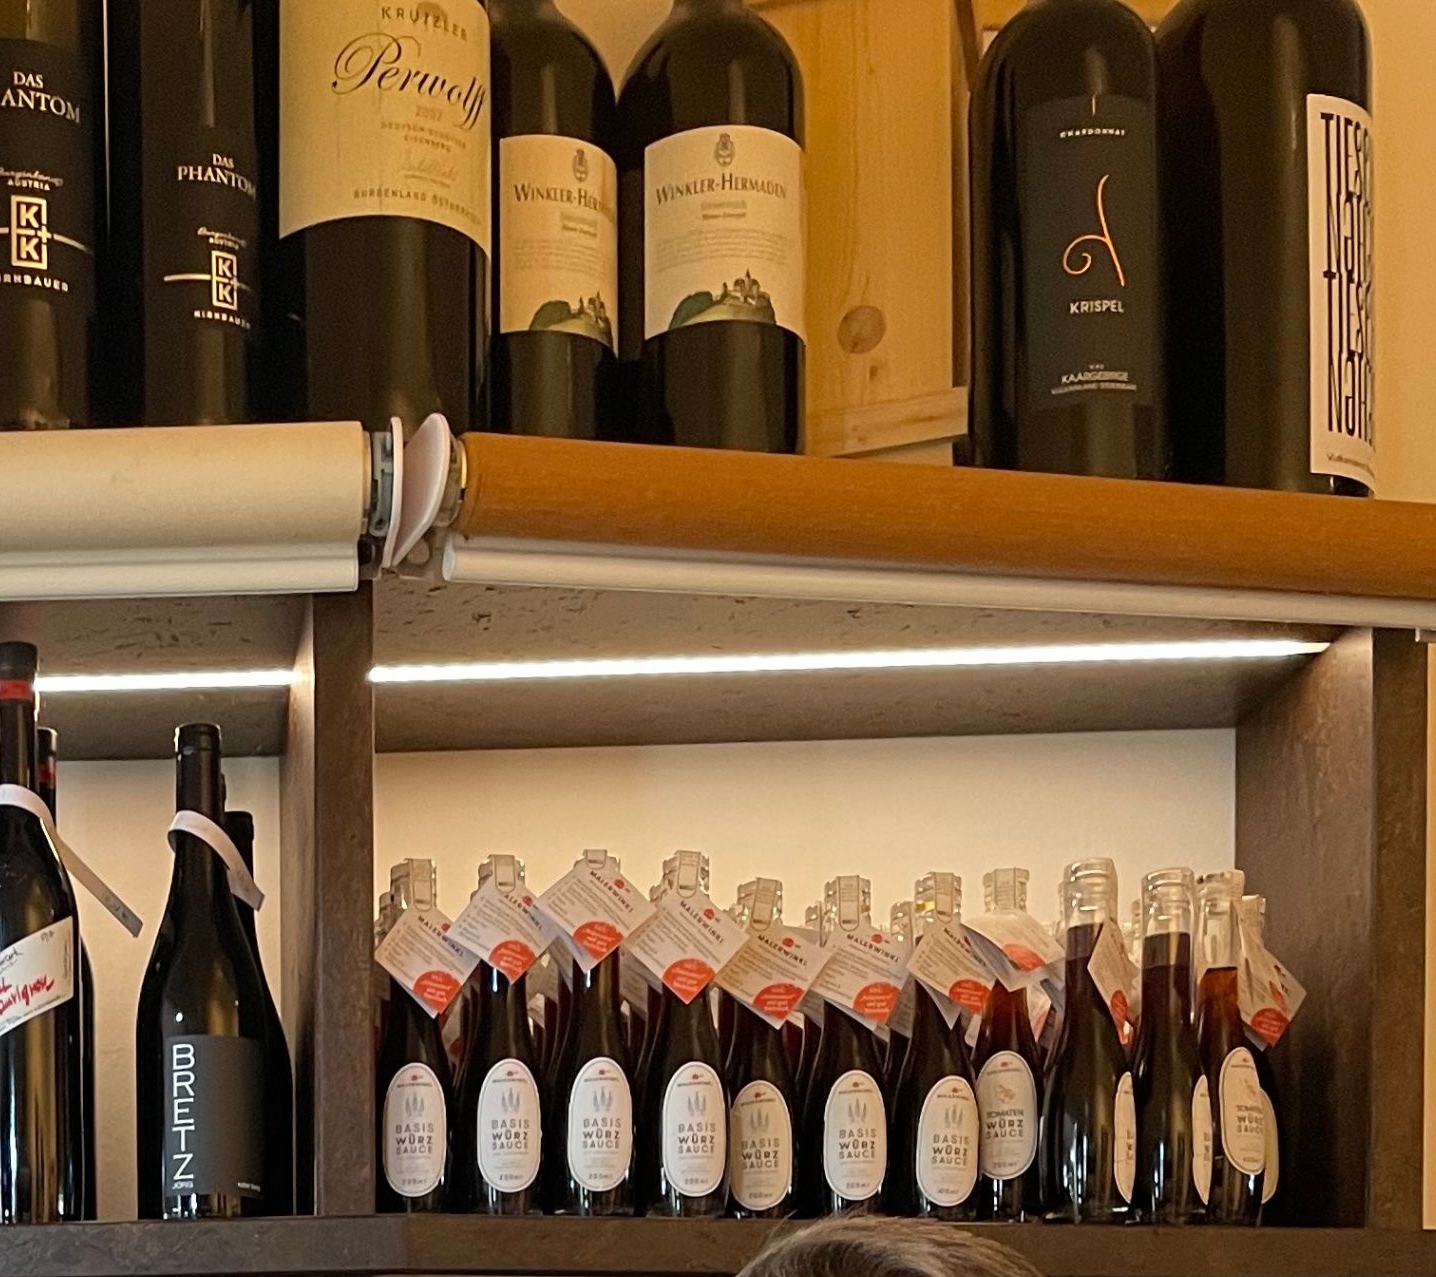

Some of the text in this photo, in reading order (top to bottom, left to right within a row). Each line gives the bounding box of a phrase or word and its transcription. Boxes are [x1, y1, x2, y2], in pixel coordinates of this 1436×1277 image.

[381, 6, 468, 41] KRUTZLER
[13, 71, 44, 89] DAS
[212, 154, 234, 169] DAS
[177, 165, 256, 200] PHANTOM
[1070, 300, 1124, 314] KRISPEL
[172, 1043, 195, 1180] BRETZ
[395, 1123, 435, 1134] BASIS
[491, 1118, 530, 1130] BASIS
[583, 1117, 622, 1129] BASIS
[678, 1122, 716, 1134] BASIS
[986, 1118, 1023, 1131] WÜRZ
[395, 1133, 433, 1145] WÜRZ
[491, 1129, 529, 1141] WÜRZ
[582, 1128, 621, 1140] WÜRZ
[678, 1132, 716, 1145] WÜRZ
[839, 1128, 877, 1139] BASIS
[985, 1128, 1023, 1140] SAUCE
[396, 1145, 433, 1154] SAUCE
[492, 1140, 529, 1150] SAUCE
[582, 1139, 620, 1149] SAUCE
[677, 1143, 715, 1154] SAUCE
[740, 1138, 781, 1149] BASIS
[839, 1138, 876, 1150] WÜRZ
[741, 1149, 779, 1161] WÜRZ
[839, 1149, 876, 1159] SAUCE
[742, 1159, 779, 1170] SAUCE
